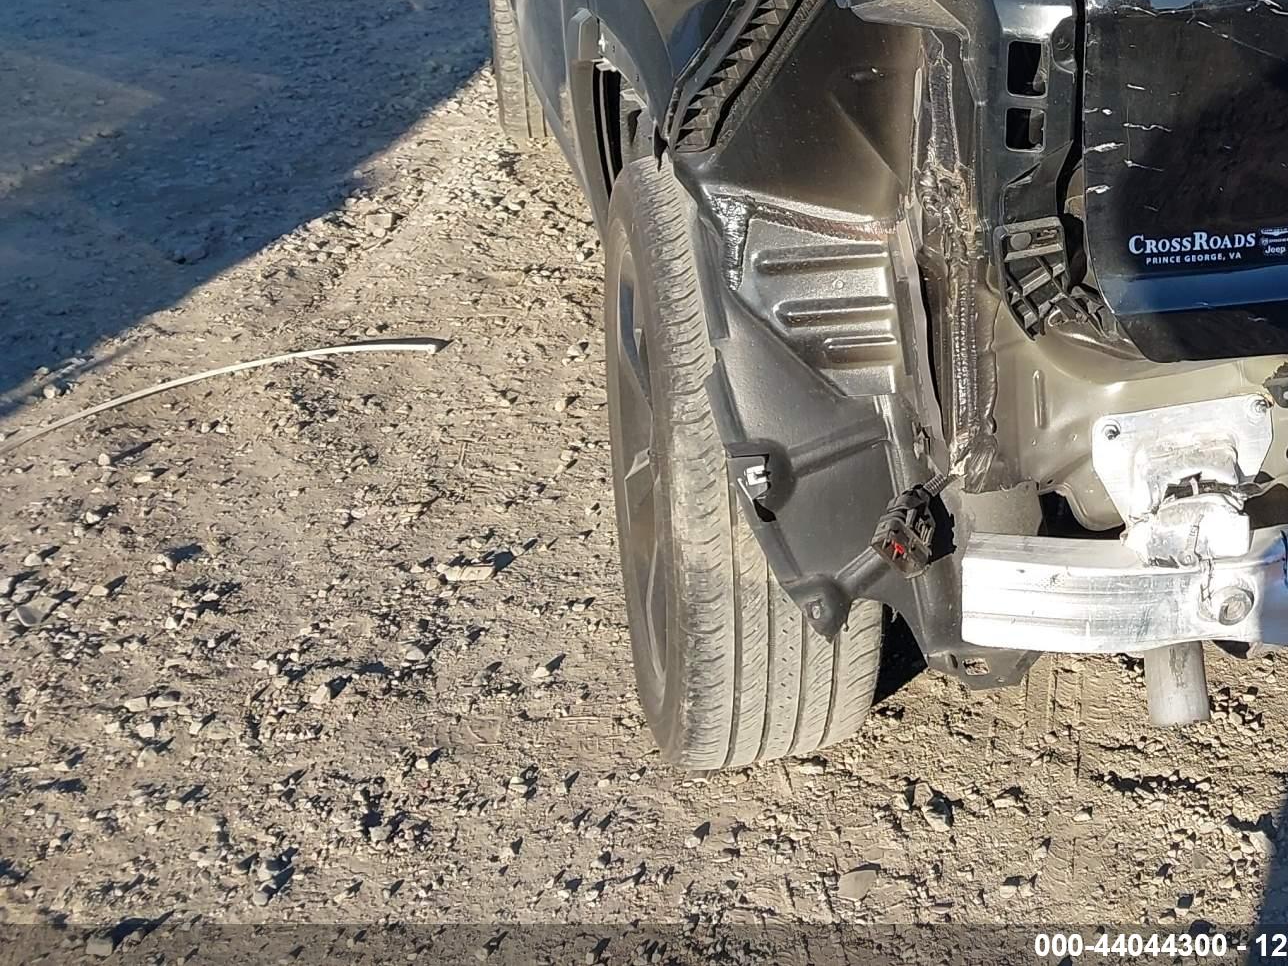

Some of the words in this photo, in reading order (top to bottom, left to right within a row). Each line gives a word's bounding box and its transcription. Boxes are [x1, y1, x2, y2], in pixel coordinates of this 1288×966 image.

[1264, 244, 1286, 254] Jeep
[1145, 255, 1181, 265] PRINCE
[1184, 252, 1226, 263] GEORGE,
[1228, 251, 1242, 260] VA
